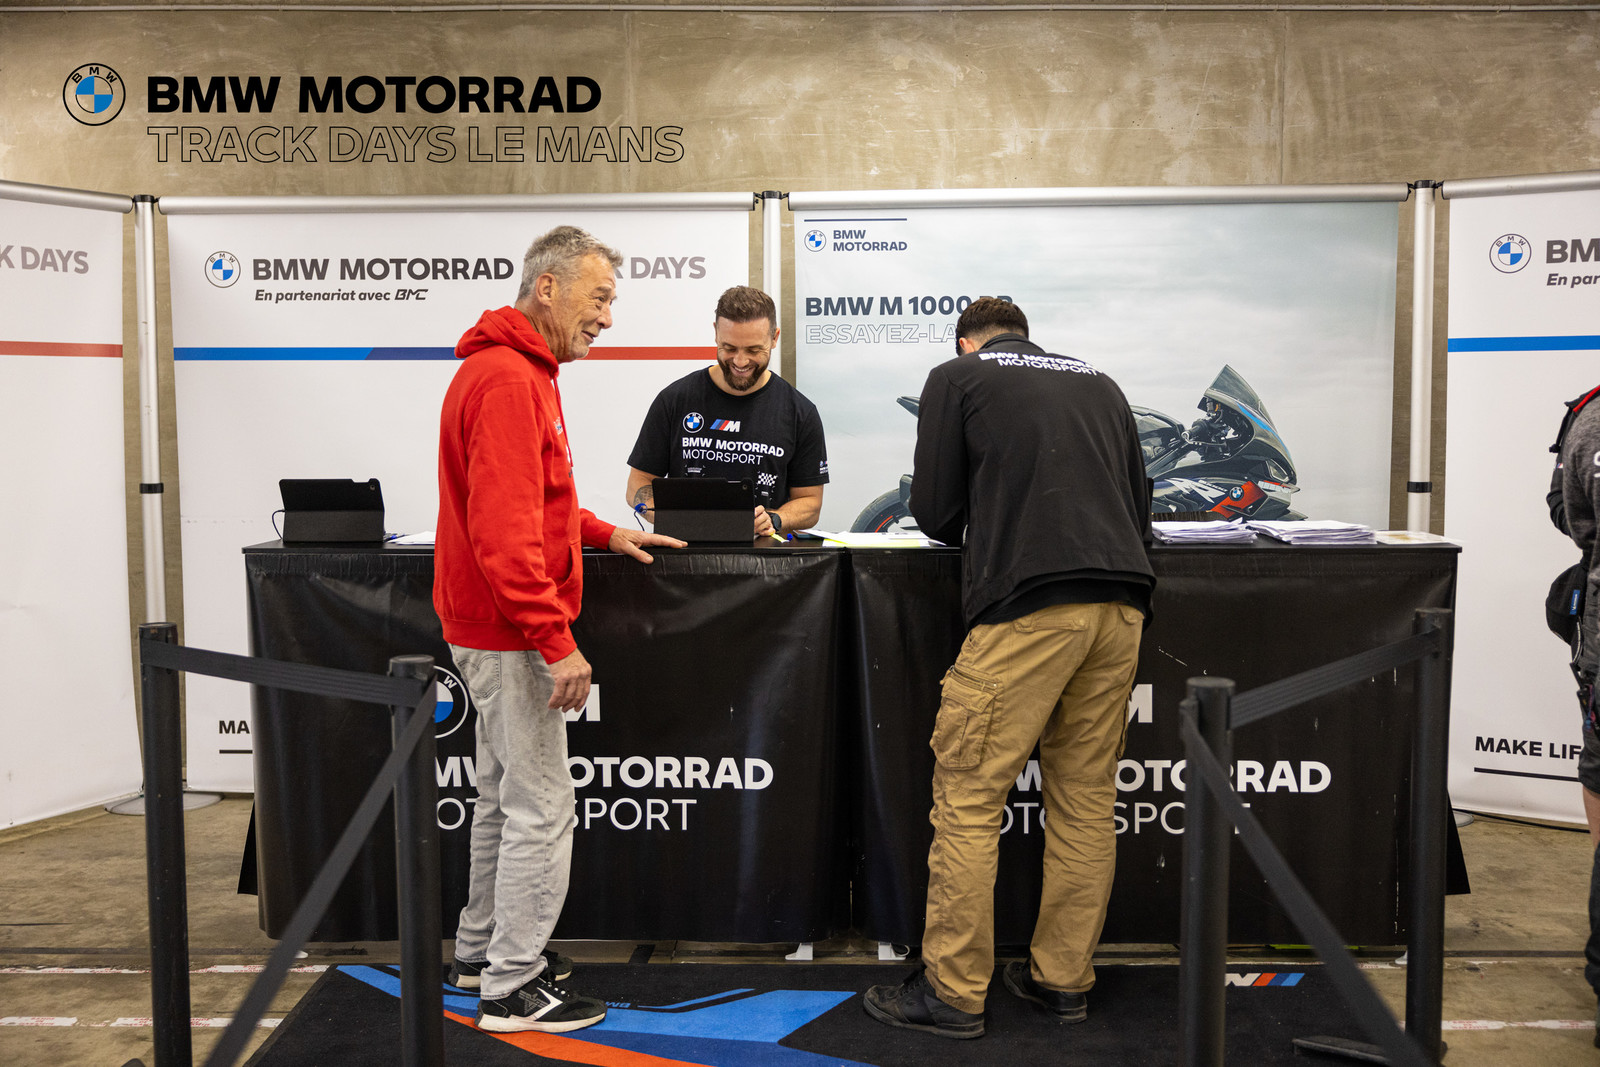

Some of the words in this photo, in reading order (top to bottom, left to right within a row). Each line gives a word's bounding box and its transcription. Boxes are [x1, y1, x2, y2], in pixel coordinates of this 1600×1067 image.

[832, 229, 866, 239] BMW
[832, 241, 908, 252] MOTORRAD
[1546, 238, 1600, 264] BM
[20, 246, 89, 275] DAYS
[252, 258, 330, 281] BMW
[339, 257, 514, 281] MOTORRAD
[630, 256, 706, 279] DAYS
[1546, 273, 1568, 286] En
[254, 289, 273, 301] En
[274, 288, 356, 304] partenariat
[358, 290, 391, 301] avec
[805, 297, 874, 317] BMW
[879, 297, 903, 315] M
[908, 295, 972, 316] 1000
[978, 352, 1019, 361] BMW
[998, 358, 1098, 376] MOTORSPORT
[681, 437, 713, 448] BMW
[715, 439, 785, 458] MOTORRAD
[682, 449, 764, 466] MOTORSPORT
[219, 720, 251, 734] MA
[1475, 736, 1543, 757] MAKE
[1549, 742, 1582, 760] LIF
[567, 756, 774, 790] OTORRAD
